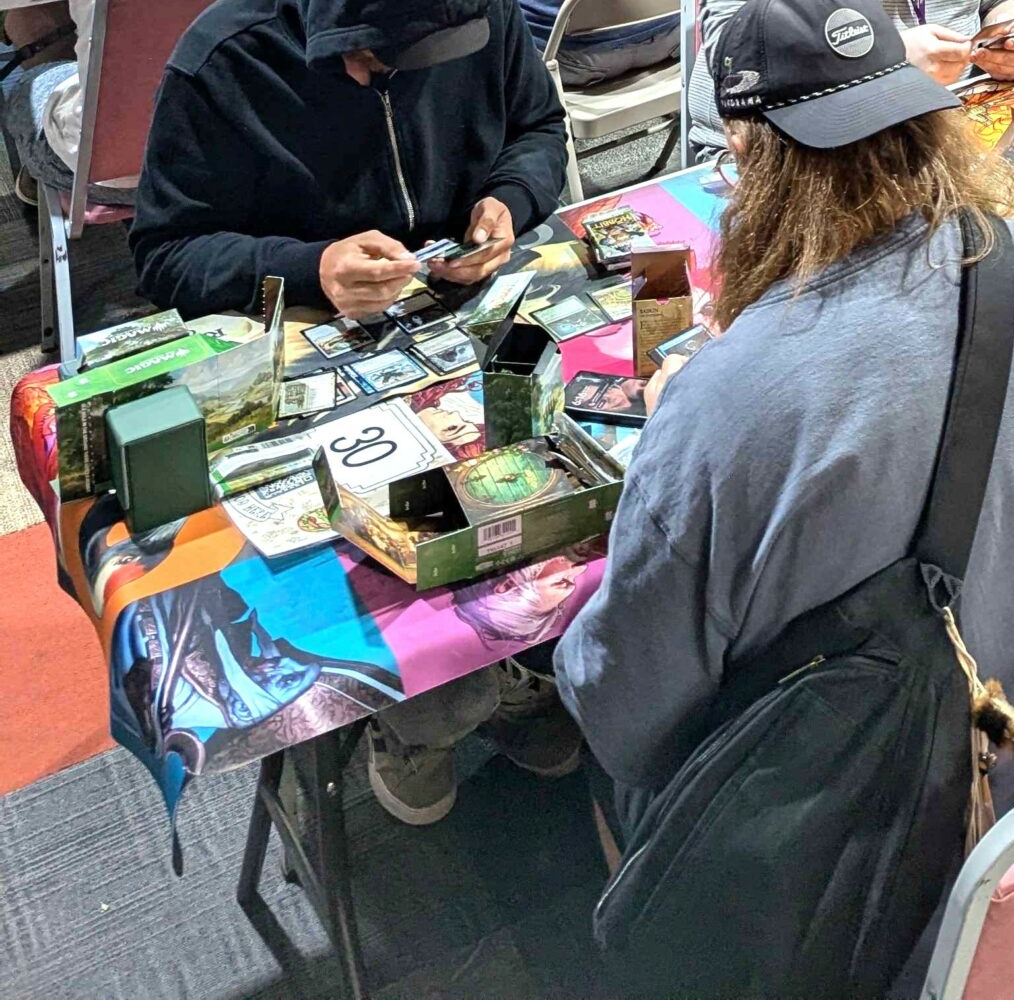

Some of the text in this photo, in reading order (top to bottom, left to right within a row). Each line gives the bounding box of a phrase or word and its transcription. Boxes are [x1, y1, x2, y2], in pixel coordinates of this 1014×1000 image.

[831, 24, 870, 46] Titleist
[101, 327, 151, 347] MAGIC
[126, 351, 176, 374] MAGIC
[329, 426, 398, 468] 30
